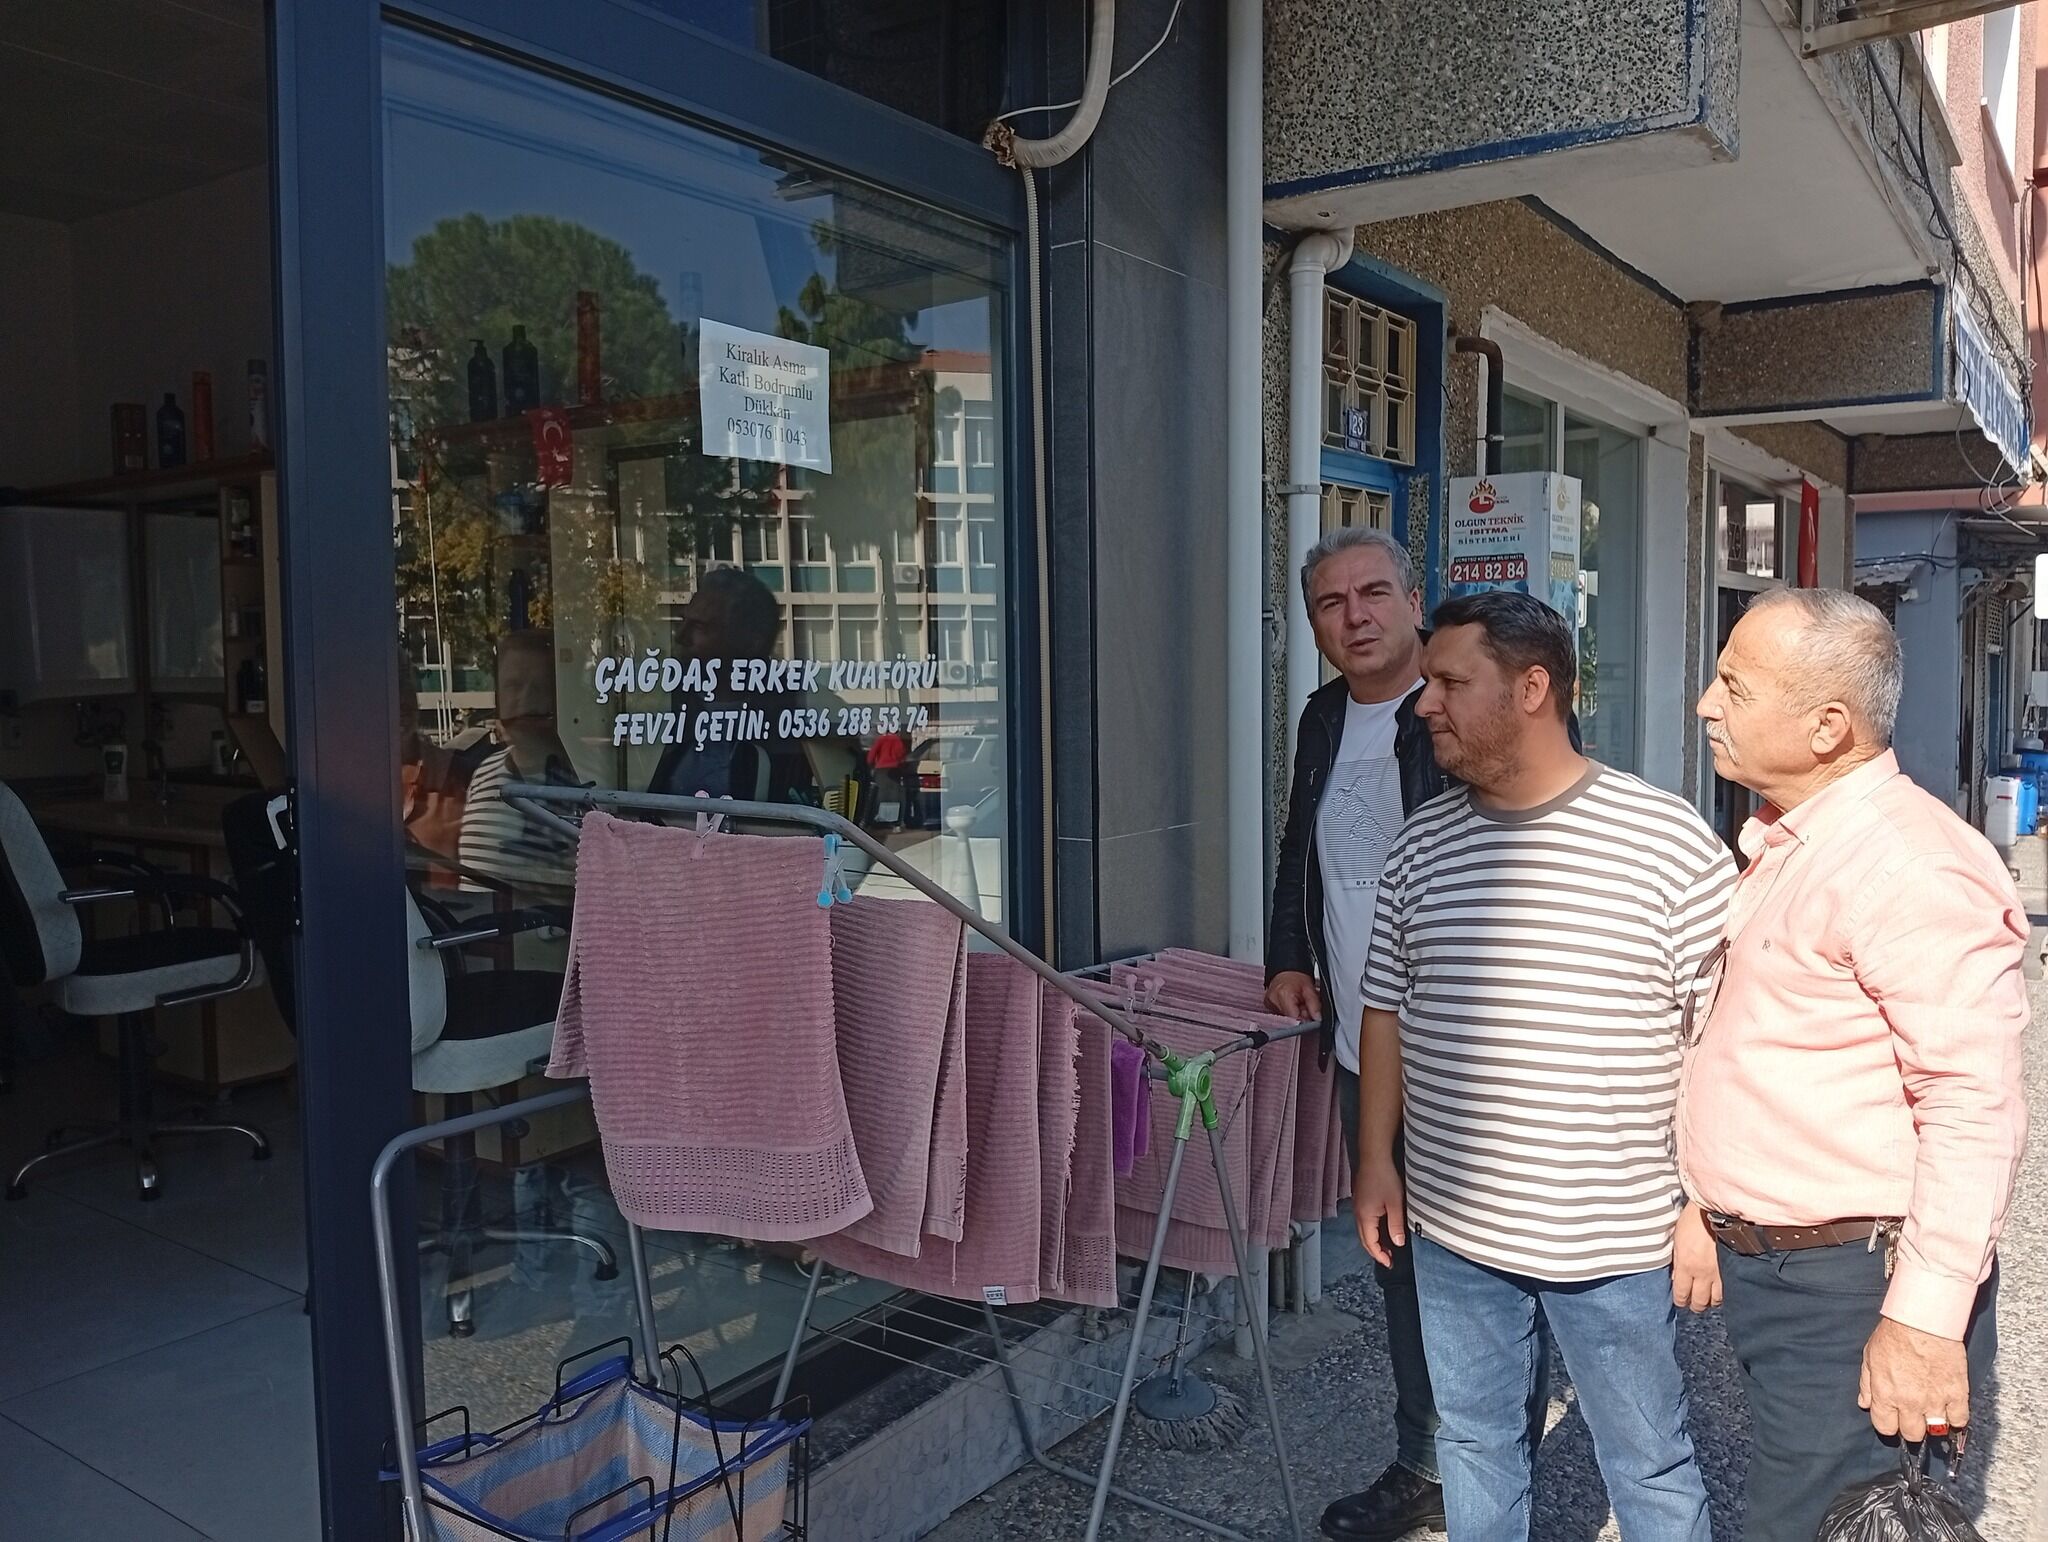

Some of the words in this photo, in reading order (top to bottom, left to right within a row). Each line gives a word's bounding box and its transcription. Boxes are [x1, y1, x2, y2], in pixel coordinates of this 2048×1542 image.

[726, 343, 769, 367] Kiralık
[773, 355, 807, 376] Asma
[719, 366, 750, 388] Katlı
[754, 374, 813, 401] Bodrumlu
[744, 396, 791, 420] Dükkan
[727, 417, 807, 447] 05307611043
[1454, 518, 1486, 528] OLGUN
[1487, 513, 1525, 527] TEKNİK
[1469, 527, 1509, 536] ISITMA
[1458, 533, 1521, 545] SİSTEMLERİ
[1453, 564, 1480, 582] 214
[1484, 563, 1502, 580] 82
[1507, 561, 1525, 579] 84
[595, 648, 722, 704] ÇAĞDAŞ
[730, 658, 821, 694] ERKEK
[828, 652, 937, 691] KUAFÖRÜ
[613, 703, 687, 747] FEVZİ
[694, 702, 770, 752] ÇETİN:
[778, 708, 831, 739] 0536
[836, 707, 872, 736] 288
[877, 706, 900, 735] 53
[906, 705, 929, 733] 74
